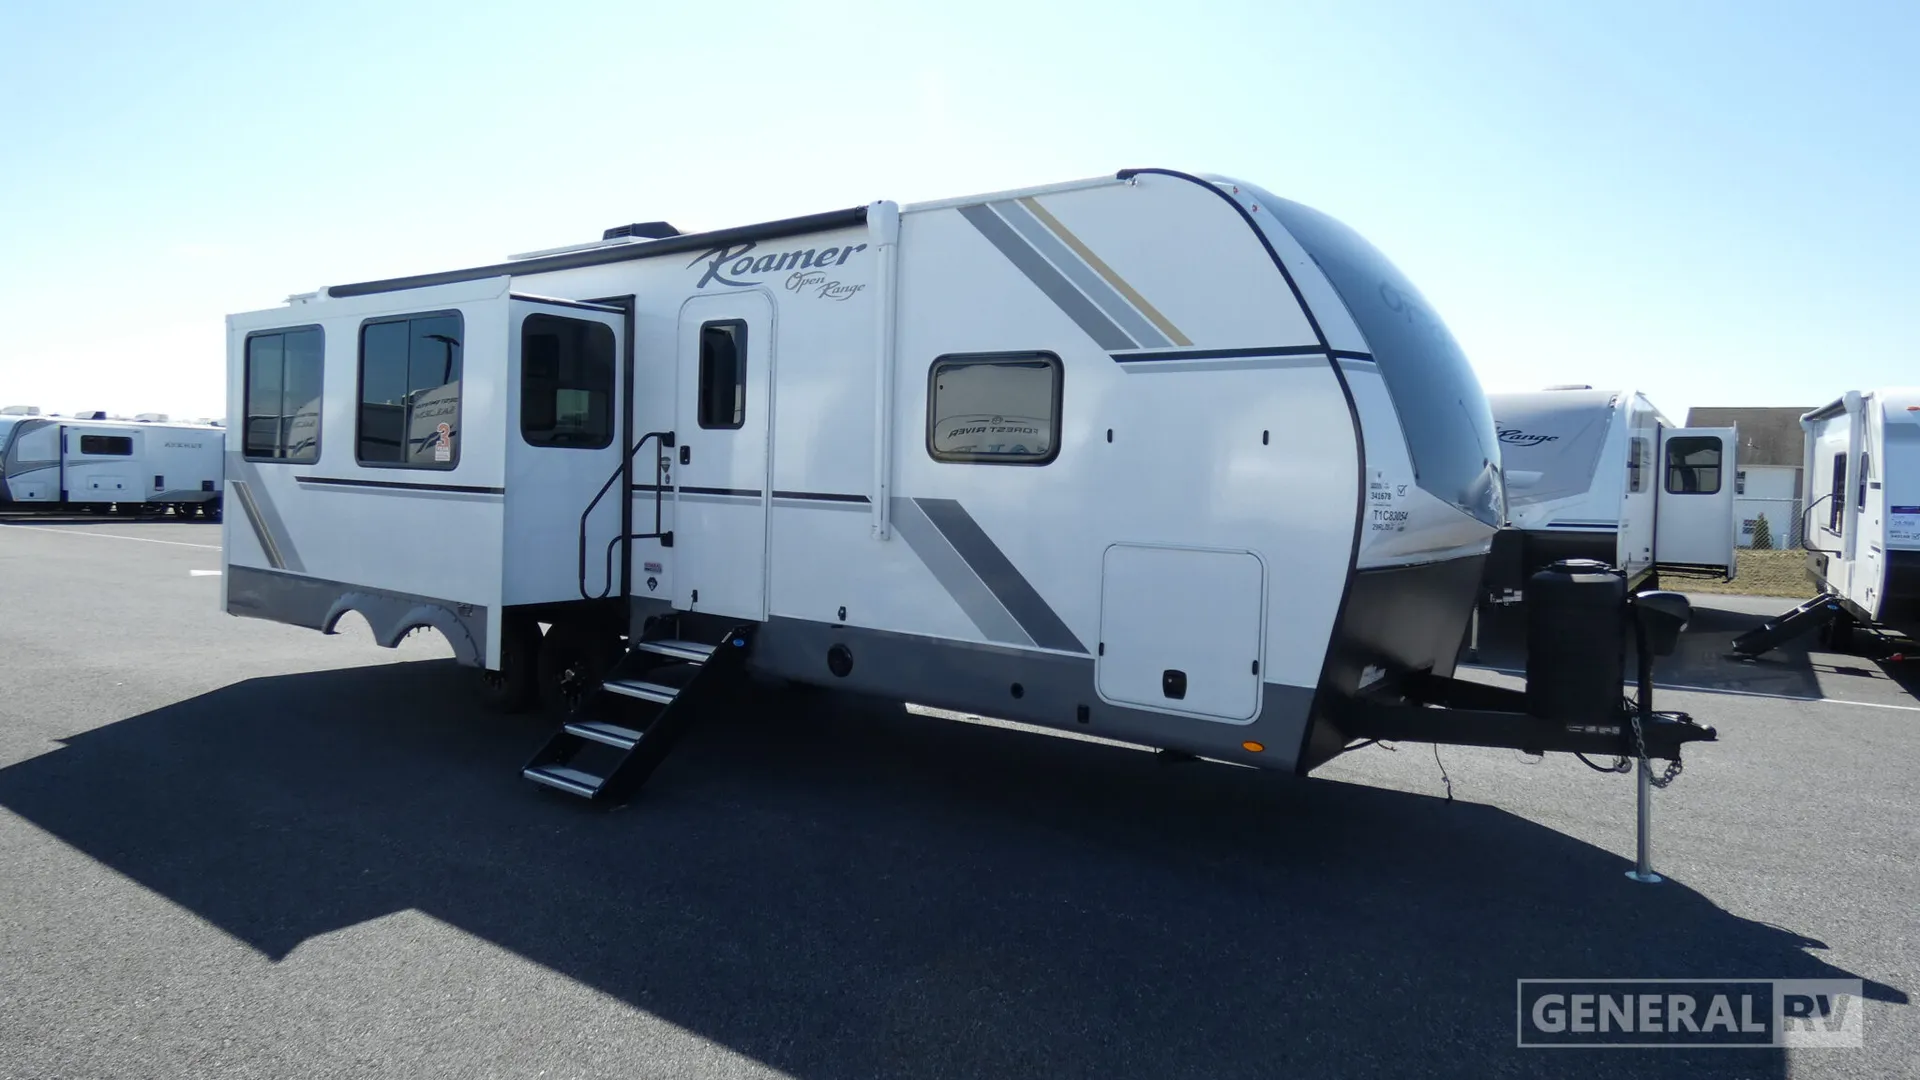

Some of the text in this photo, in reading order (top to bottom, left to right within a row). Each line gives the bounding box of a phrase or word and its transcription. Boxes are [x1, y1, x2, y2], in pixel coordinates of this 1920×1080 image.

[686, 240, 868, 288] Roamer
[785, 271, 826, 293] Open
[815, 281, 866, 301] Range
